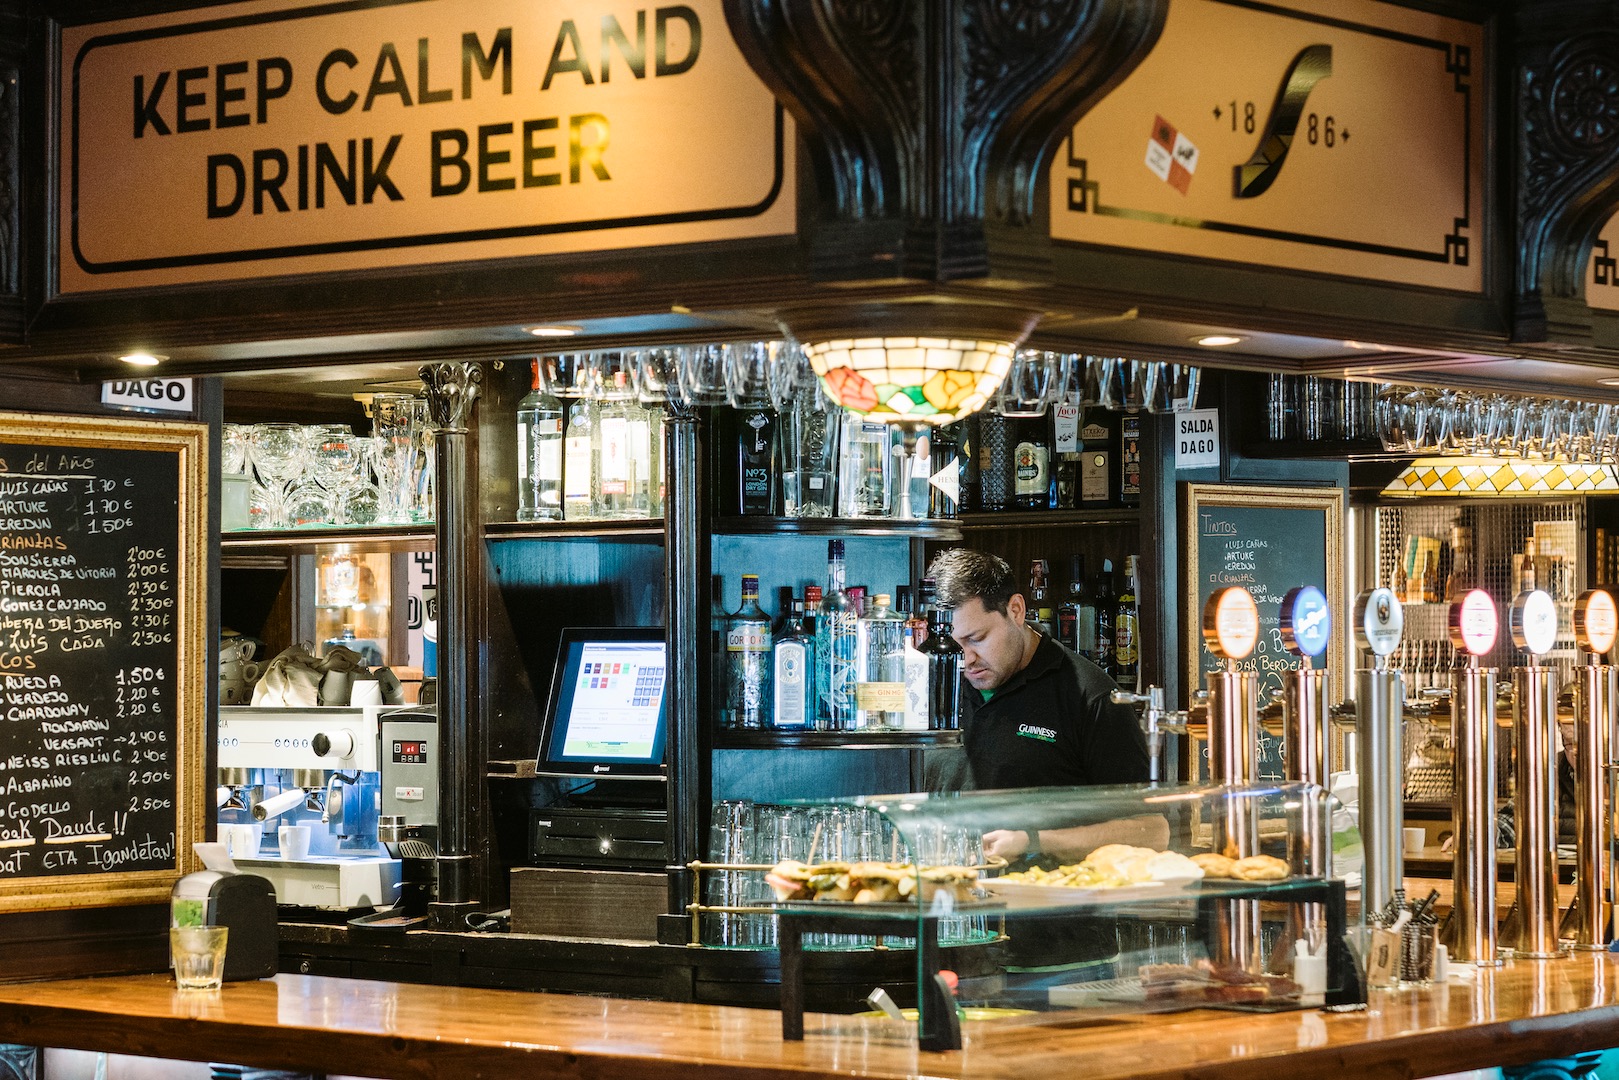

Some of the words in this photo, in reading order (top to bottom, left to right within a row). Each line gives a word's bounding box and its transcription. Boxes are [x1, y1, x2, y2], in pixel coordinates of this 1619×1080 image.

[132, 56, 293, 139] KEEP
[316, 27, 514, 116] CALM
[541, 5, 702, 91] AND
[1230, 101, 1256, 134] 18
[1308, 113, 1336, 148] 86
[206, 134, 405, 220] DRINK
[430, 113, 612, 198] BEER
[112, 380, 186, 402] DAGO
[1181, 419, 1214, 434] SALDA
[1181, 439, 1214, 454] DAGO
[5, 674, 62, 690] RUEDA
[1018, 723, 1057, 739] GUINNESS
